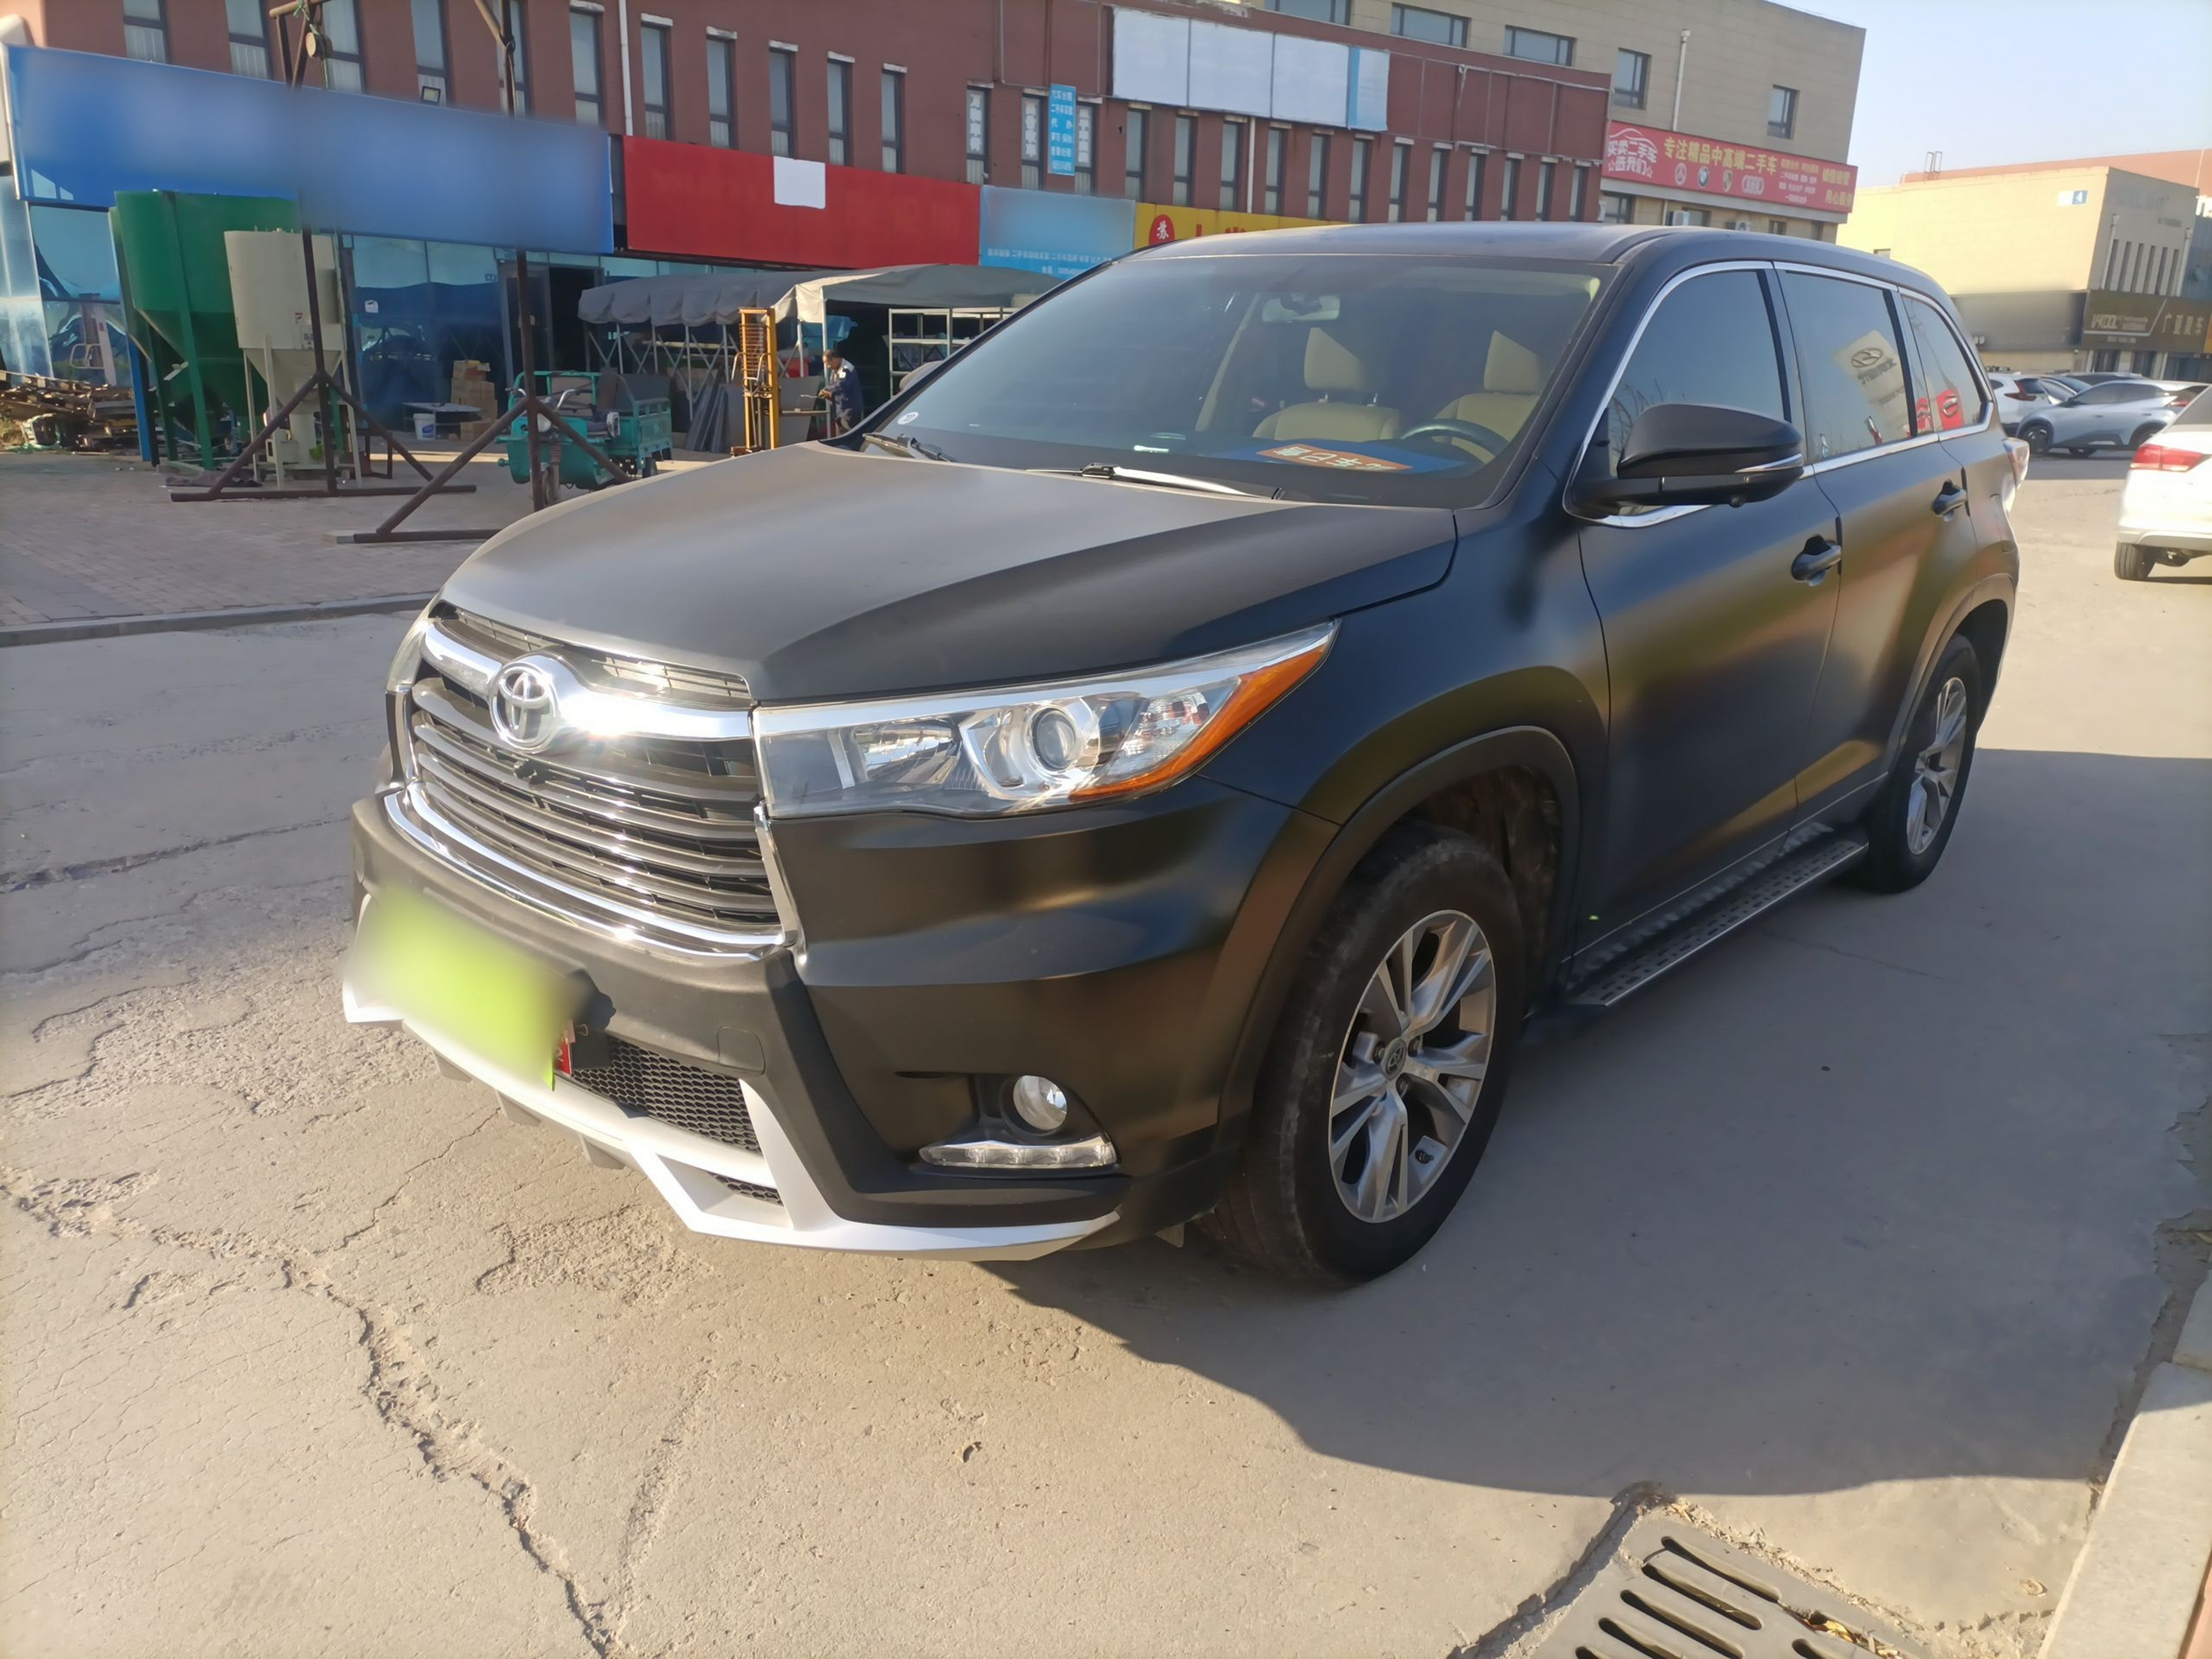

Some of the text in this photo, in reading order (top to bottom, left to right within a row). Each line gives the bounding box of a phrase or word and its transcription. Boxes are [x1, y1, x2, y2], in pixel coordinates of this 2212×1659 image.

[1608, 140, 1657, 163] 买卖二手车
[1664, 137, 1777, 175] 专注精品中高端二手车
